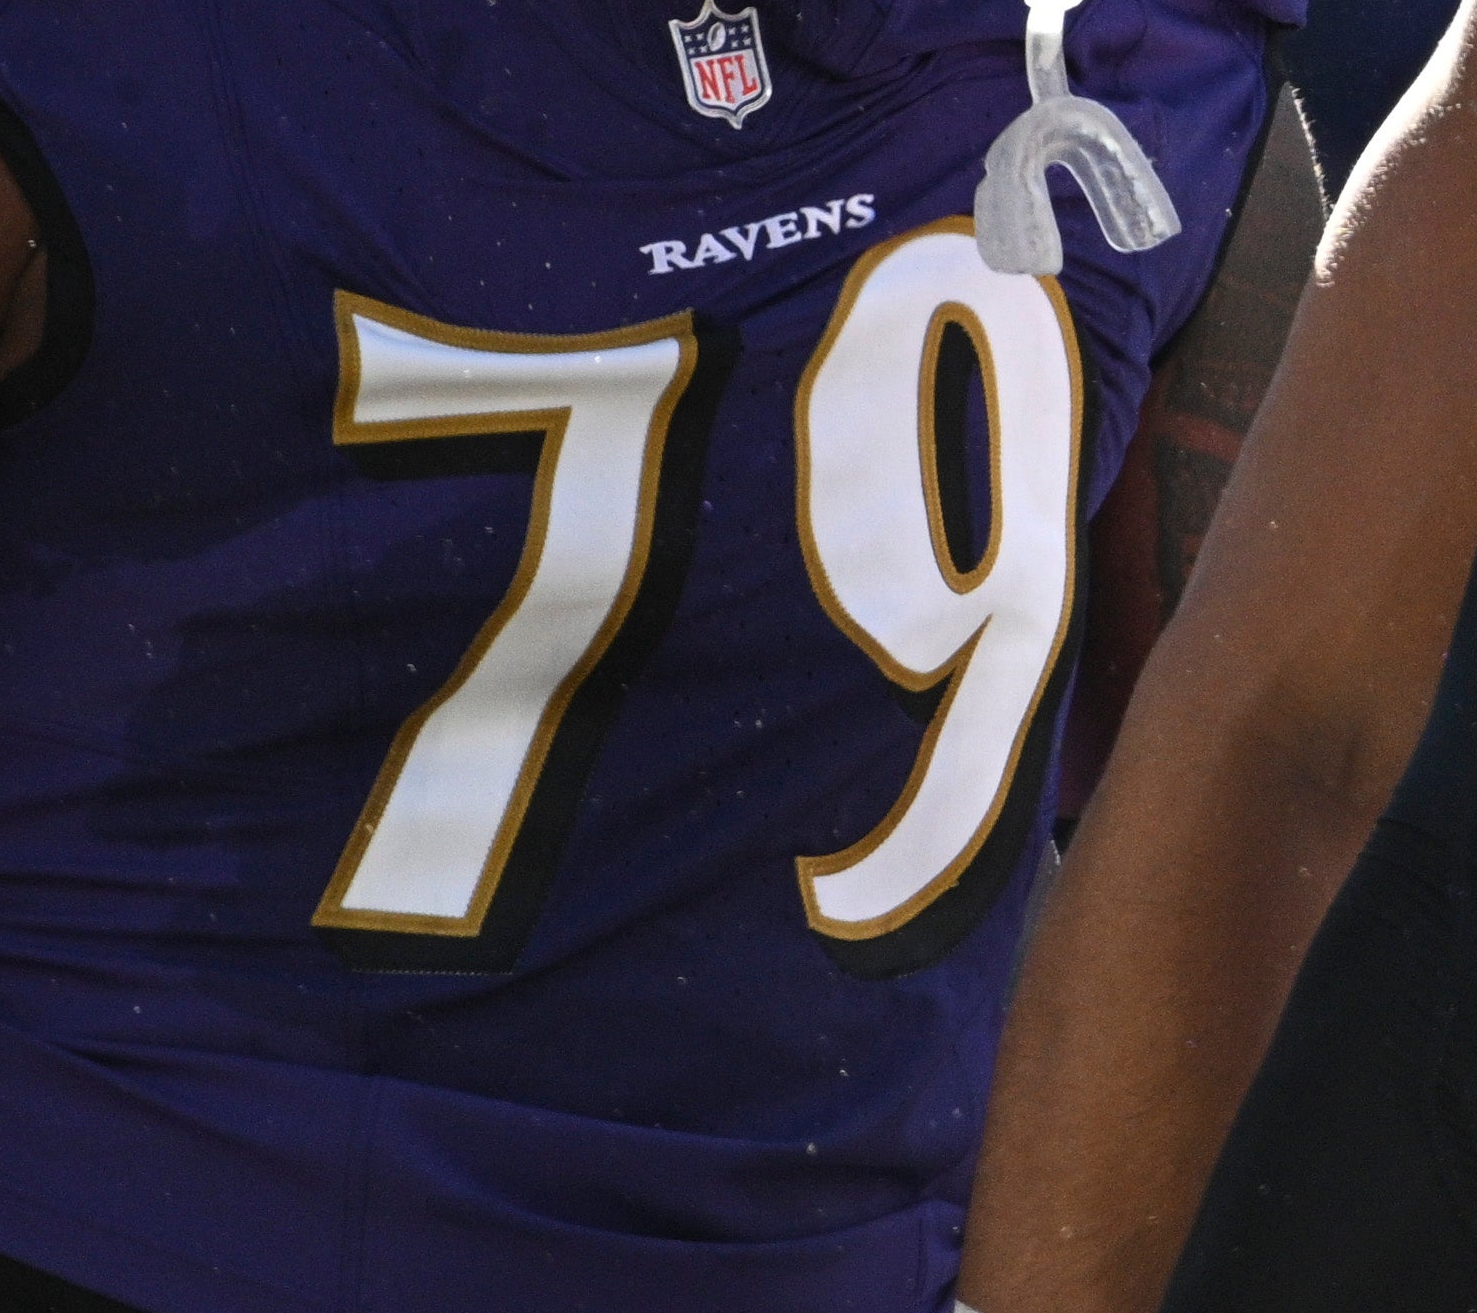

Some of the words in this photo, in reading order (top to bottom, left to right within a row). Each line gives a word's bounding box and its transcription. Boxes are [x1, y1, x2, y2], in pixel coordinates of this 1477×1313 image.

[694, 53, 758, 104] NFL
[640, 194, 877, 275] RAVENS
[311, 215, 1085, 942] 79
